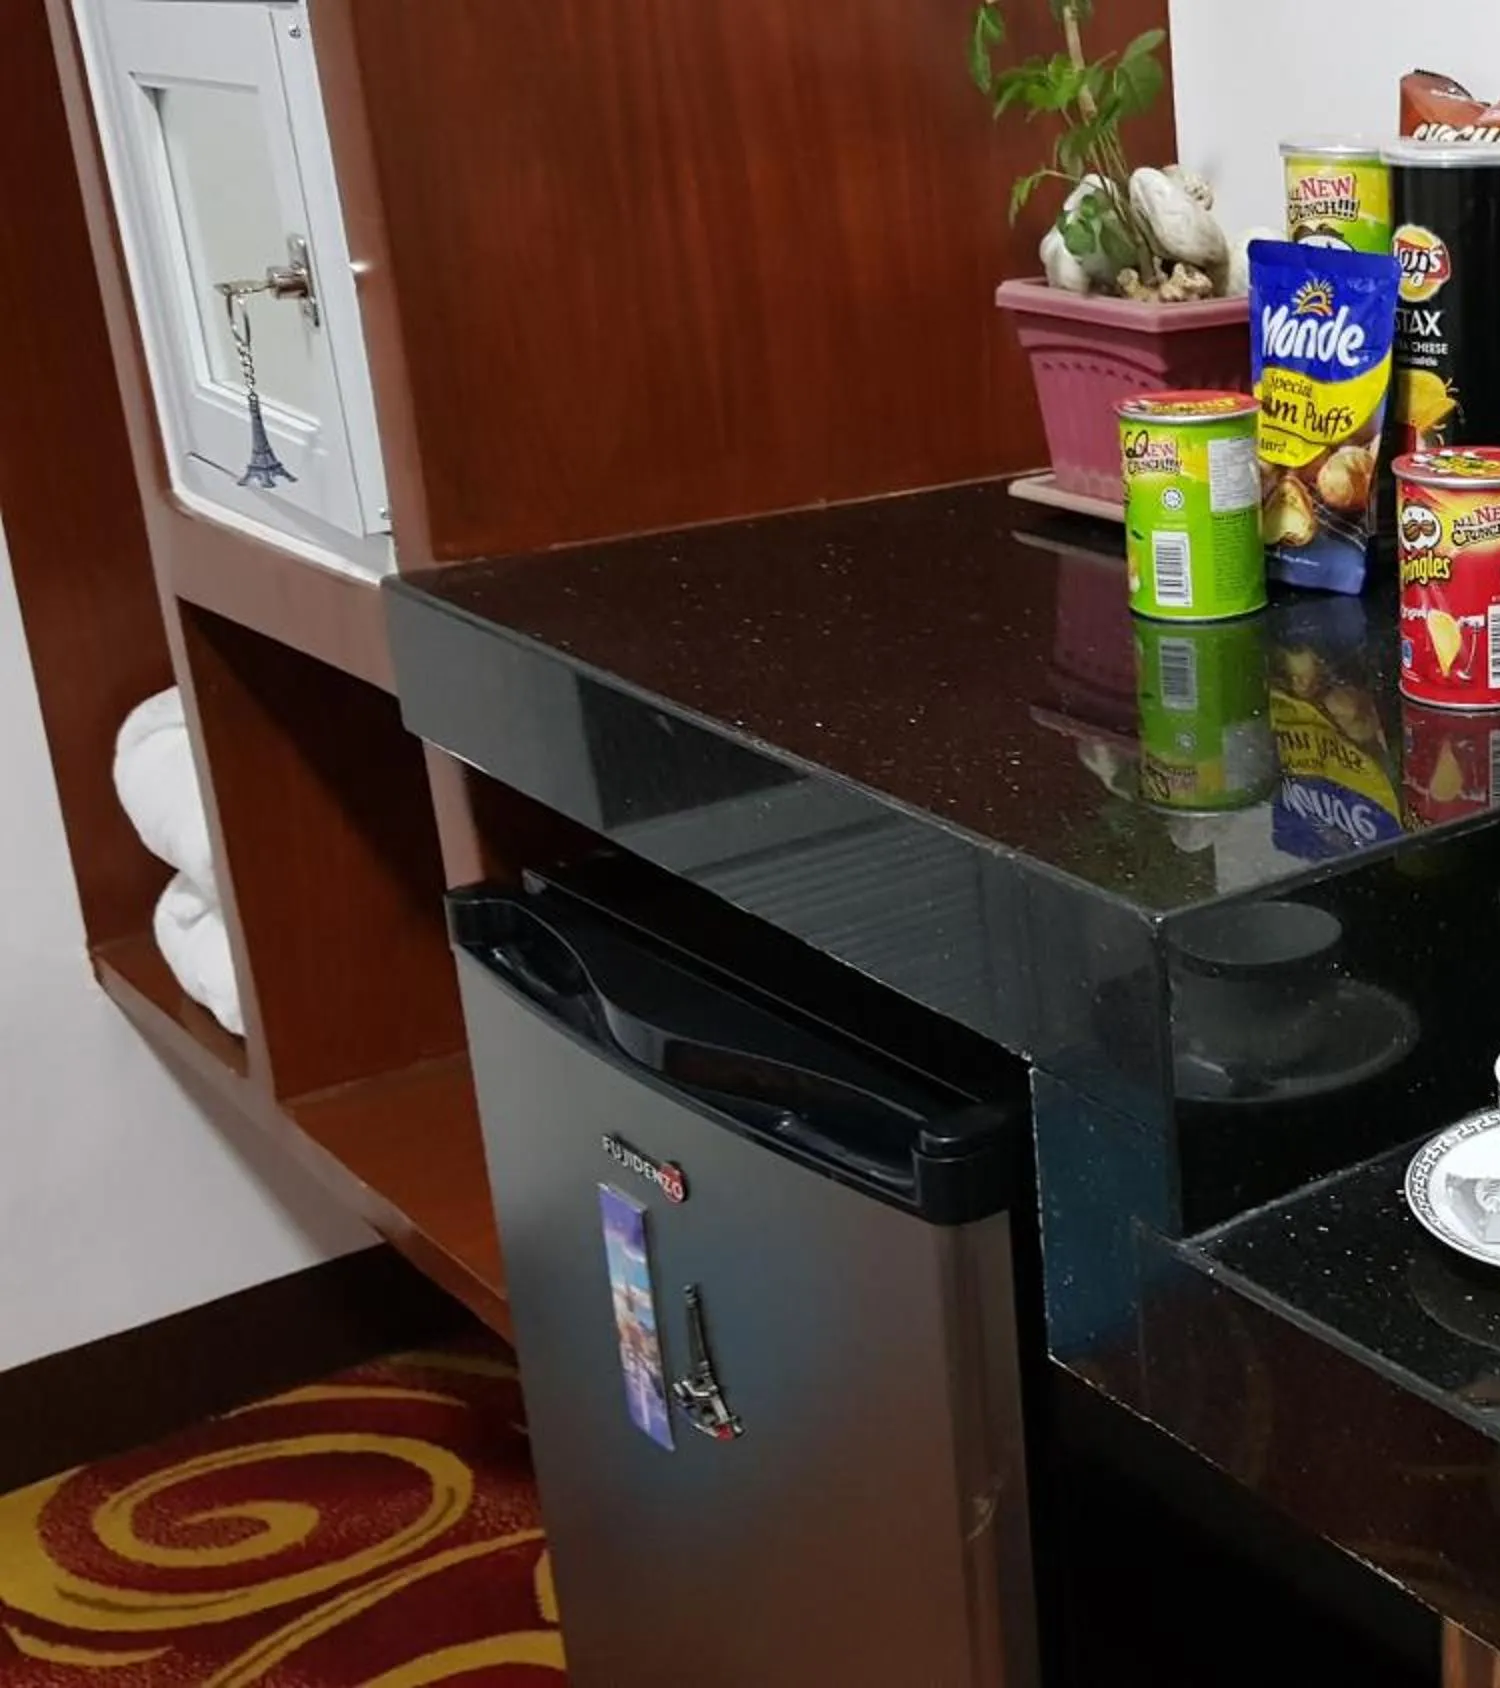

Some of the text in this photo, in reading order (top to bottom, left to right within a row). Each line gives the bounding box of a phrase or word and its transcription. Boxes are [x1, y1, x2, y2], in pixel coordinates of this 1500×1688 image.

[1300, 175, 1352, 200] NEW
[1262, 305, 1365, 367] Monde
[1304, 401, 1355, 440] Puffs
[602, 1135, 684, 1201] FUJIDENZO
